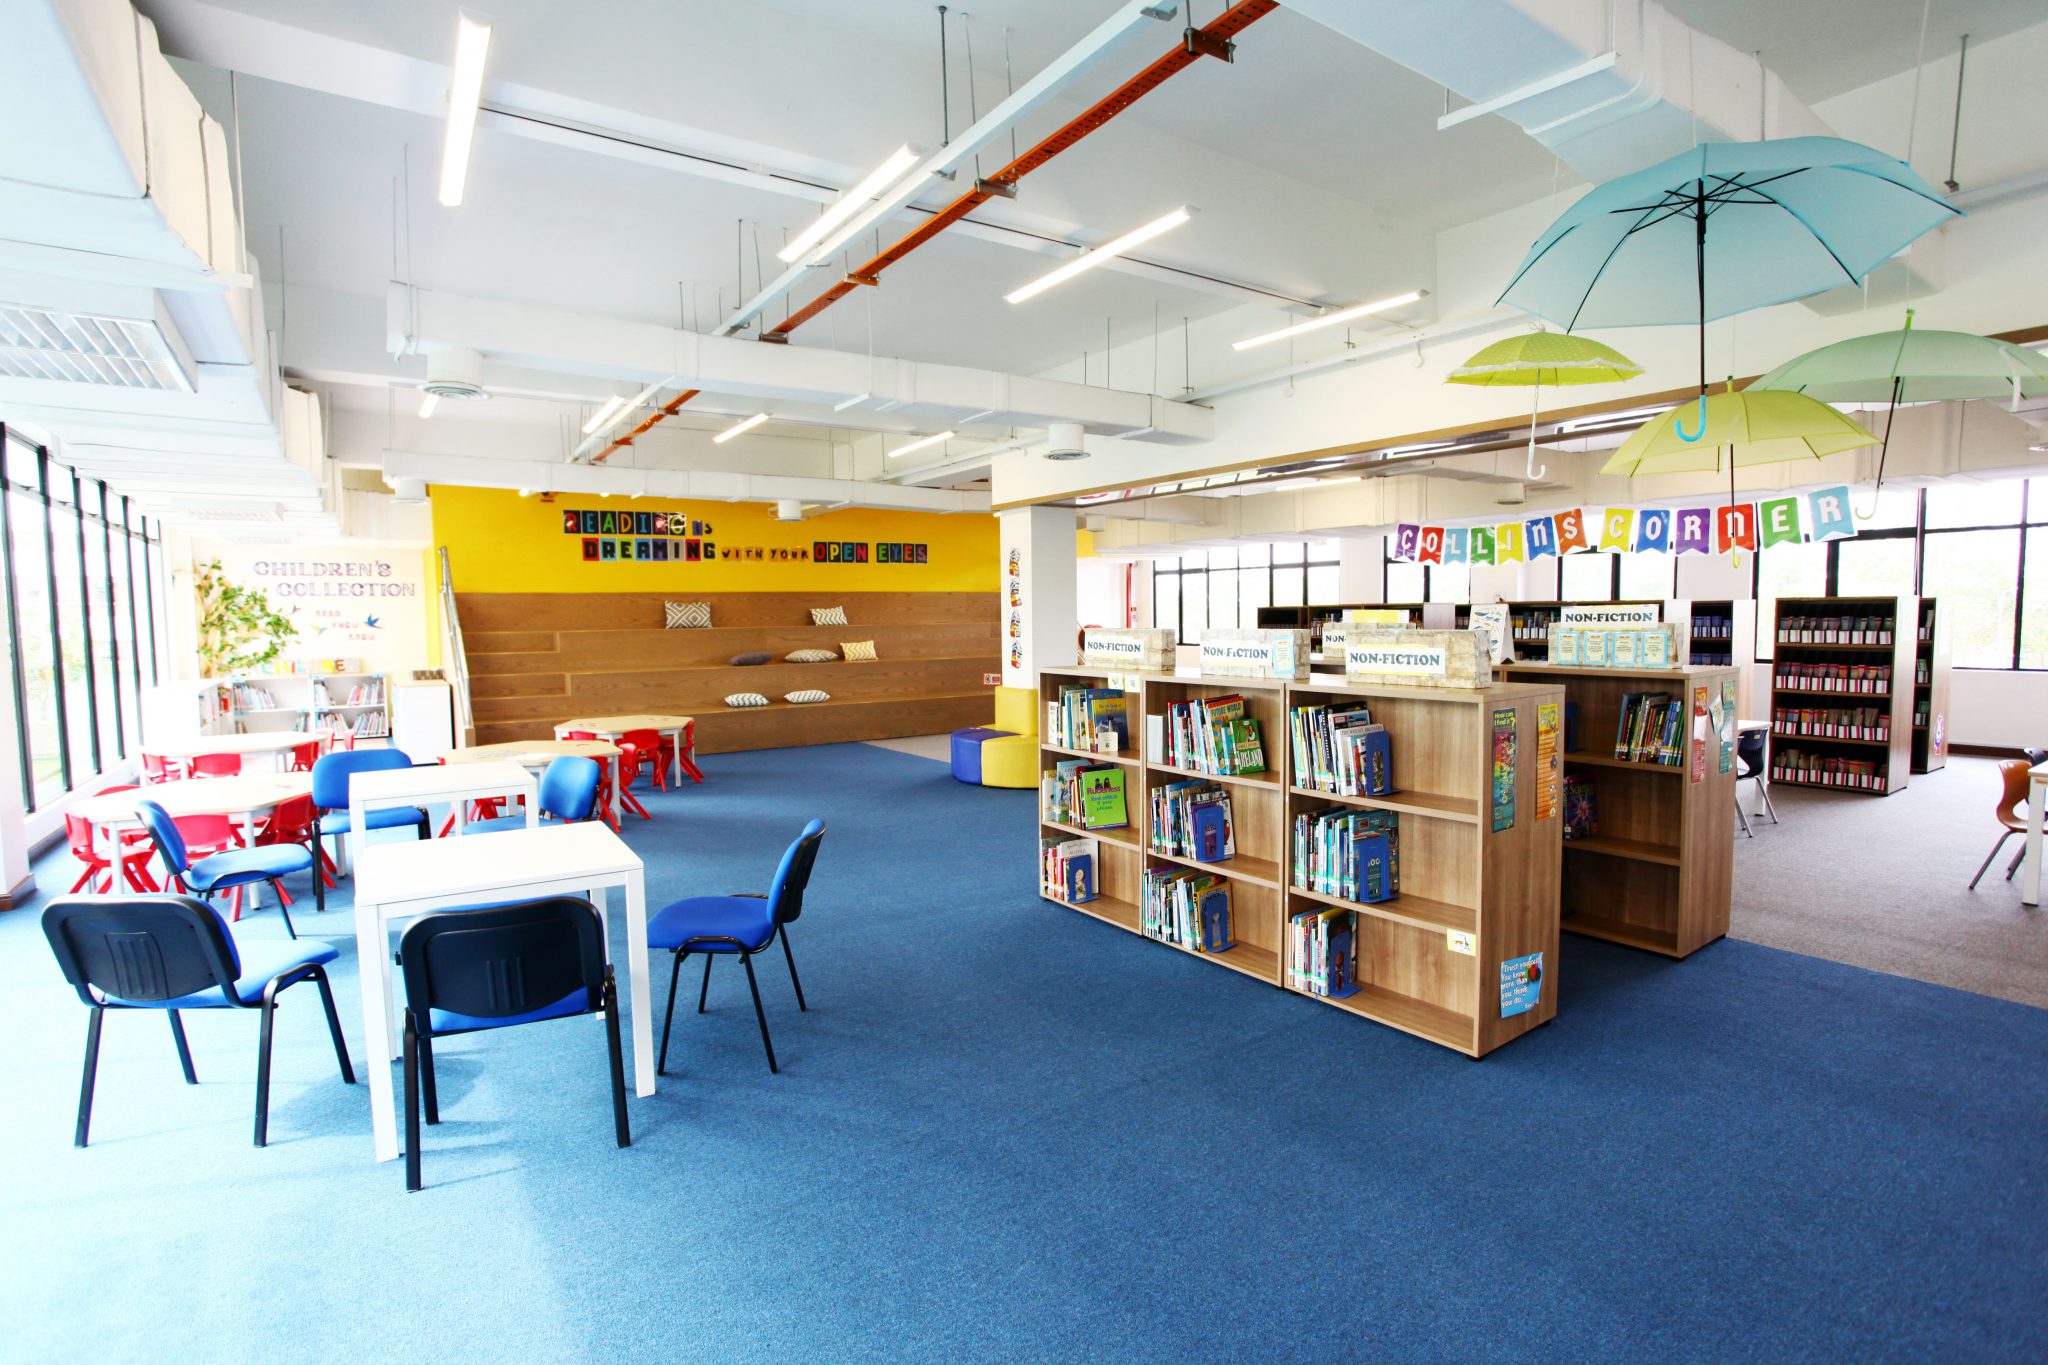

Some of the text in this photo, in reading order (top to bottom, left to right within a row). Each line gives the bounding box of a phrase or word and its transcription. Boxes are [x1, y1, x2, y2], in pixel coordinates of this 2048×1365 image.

[1401, 495, 1843, 554] COLLINS CORNER
[583, 539, 927, 562] DREAMING WITH YOUR OPEN EYES
[253, 560, 392, 577] CHILDREN'S
[276, 582, 416, 597] COLLECTION
[1565, 612, 1653, 623] NON-FICTION
[1086, 641, 1141, 653] NON-FICTION
[1203, 646, 1269, 659] NON-FICTION
[1350, 652, 1441, 666] NON-FICTION
[1514, 986, 1528, 995] think
